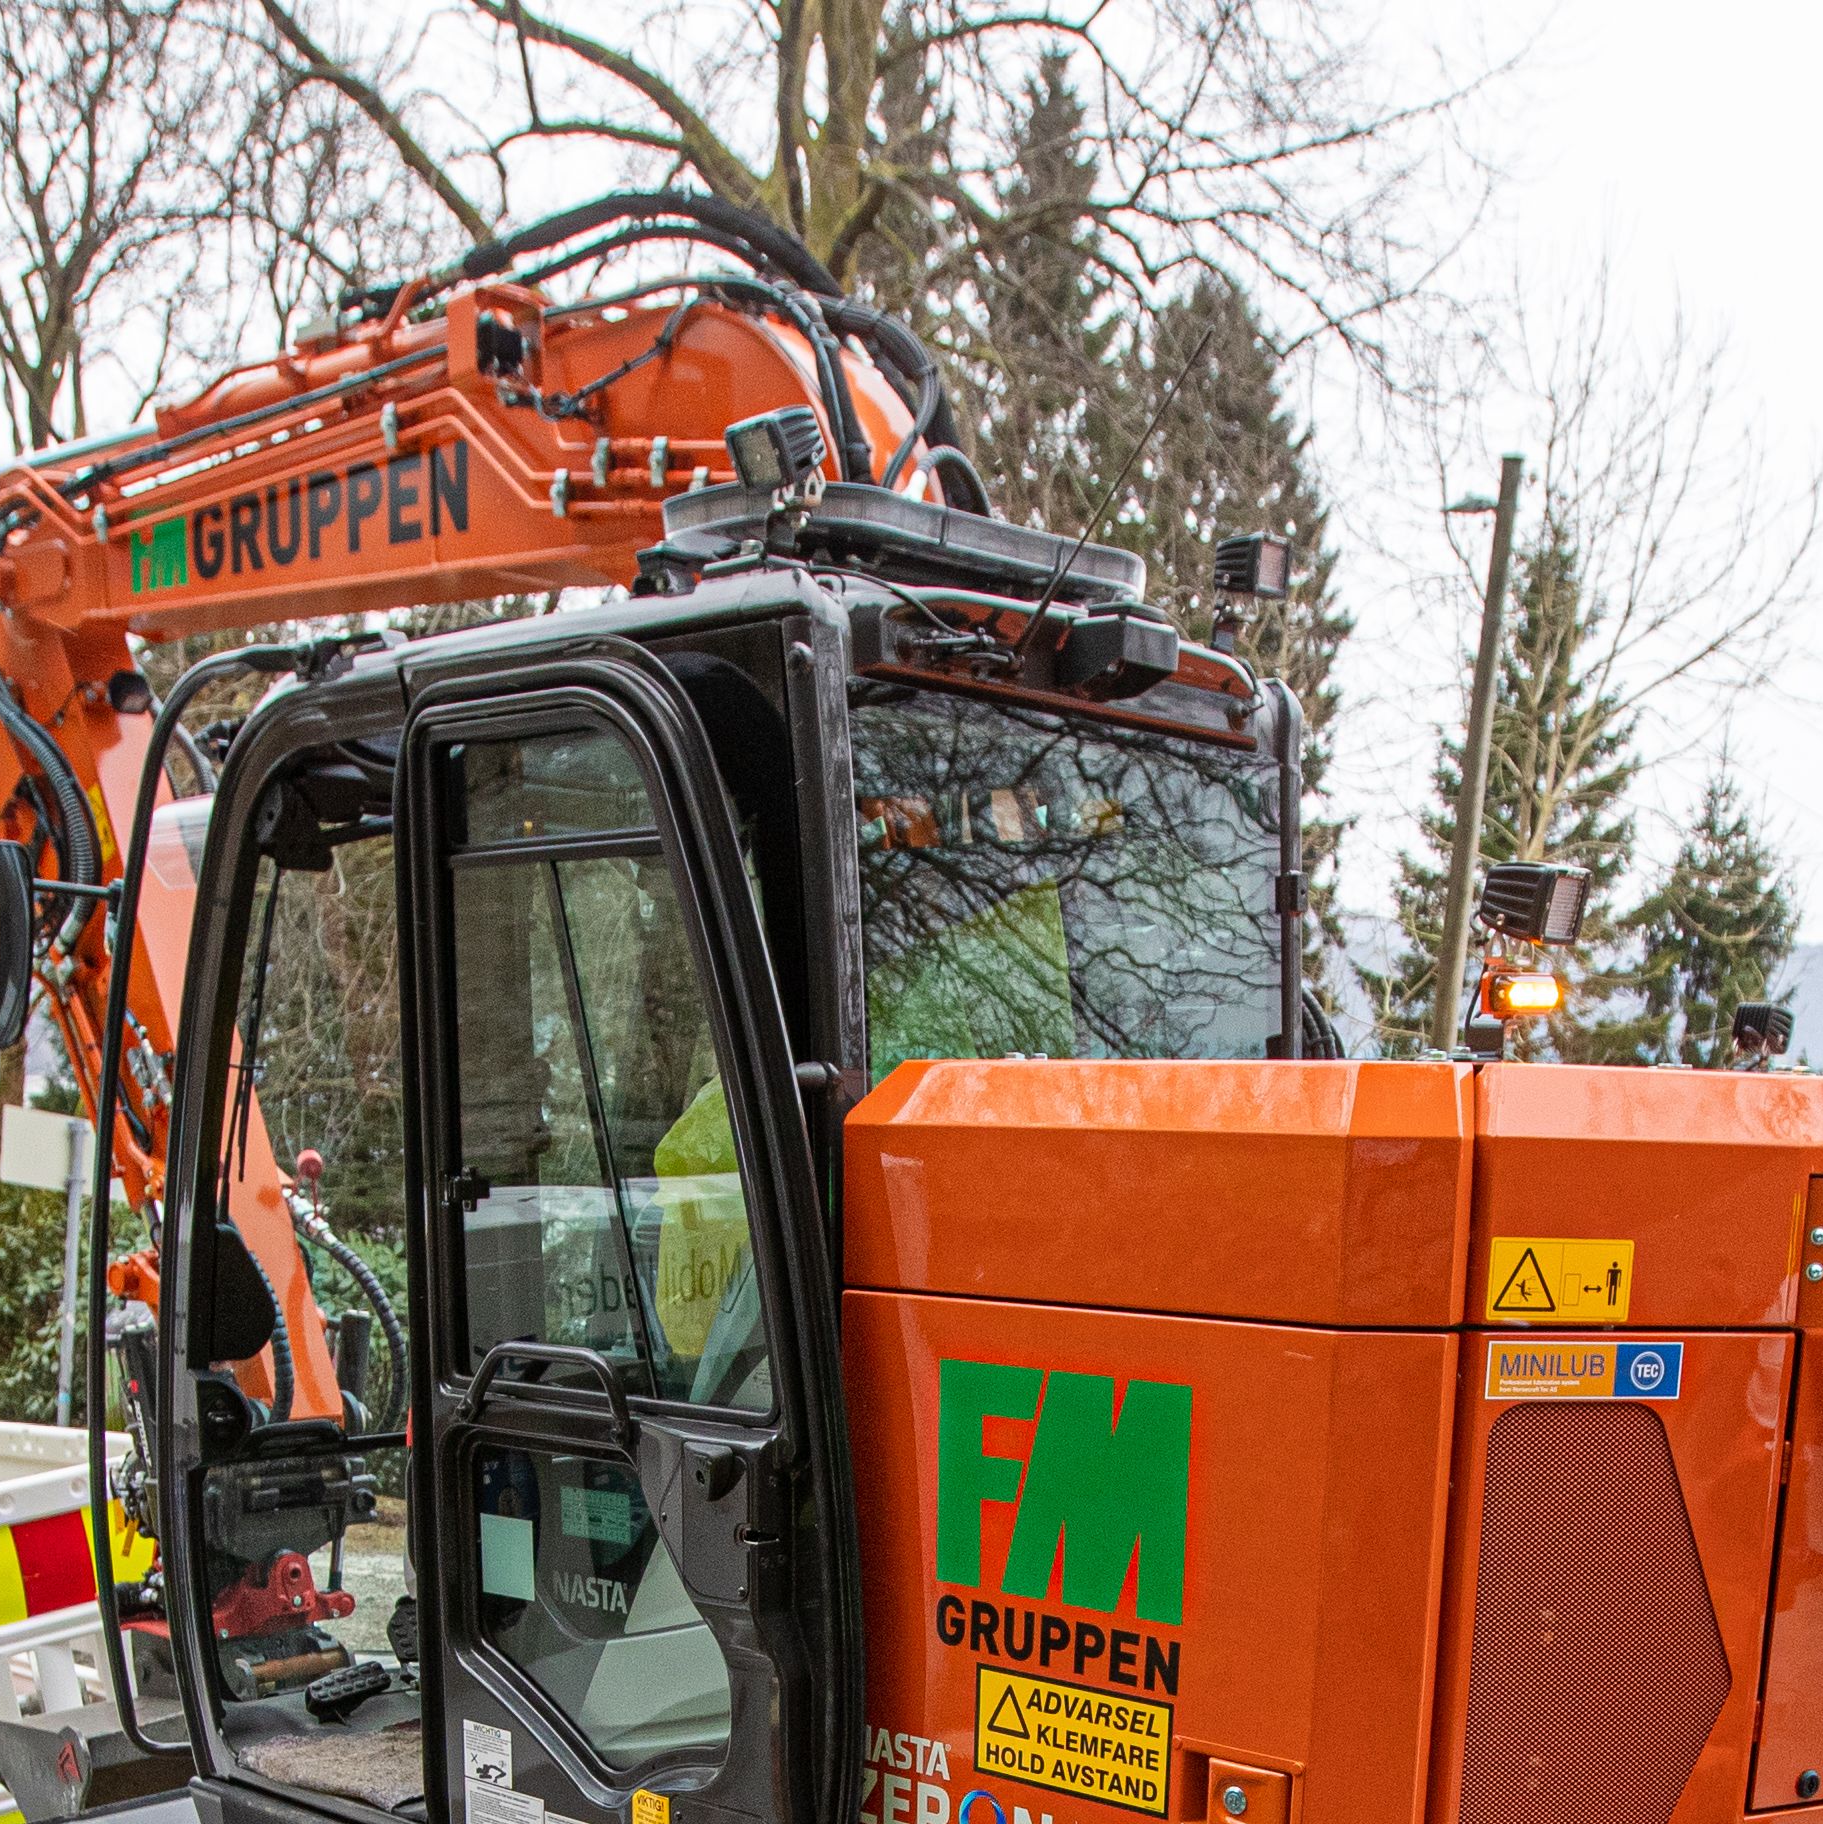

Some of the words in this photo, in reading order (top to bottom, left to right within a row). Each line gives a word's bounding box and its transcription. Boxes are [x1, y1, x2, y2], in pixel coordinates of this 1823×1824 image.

[192, 440, 469, 580] GRUPPEN
[1500, 1353, 1605, 1377] MINILUB
[1636, 1363, 1659, 1379] TEC
[936, 1358, 1192, 1627] FM
[554, 1570, 628, 1614] NASTA
[936, 1595, 1181, 1697] GRUPPEN
[1026, 1688, 1160, 1738] ADVARSEL
[986, 1742, 1044, 1775] HOLD
[1051, 1759, 1158, 1802] AVSTAND
[1036, 1724, 1160, 1772] KLEMFARE
[636, 1794, 665, 1813] VIKTIG!
